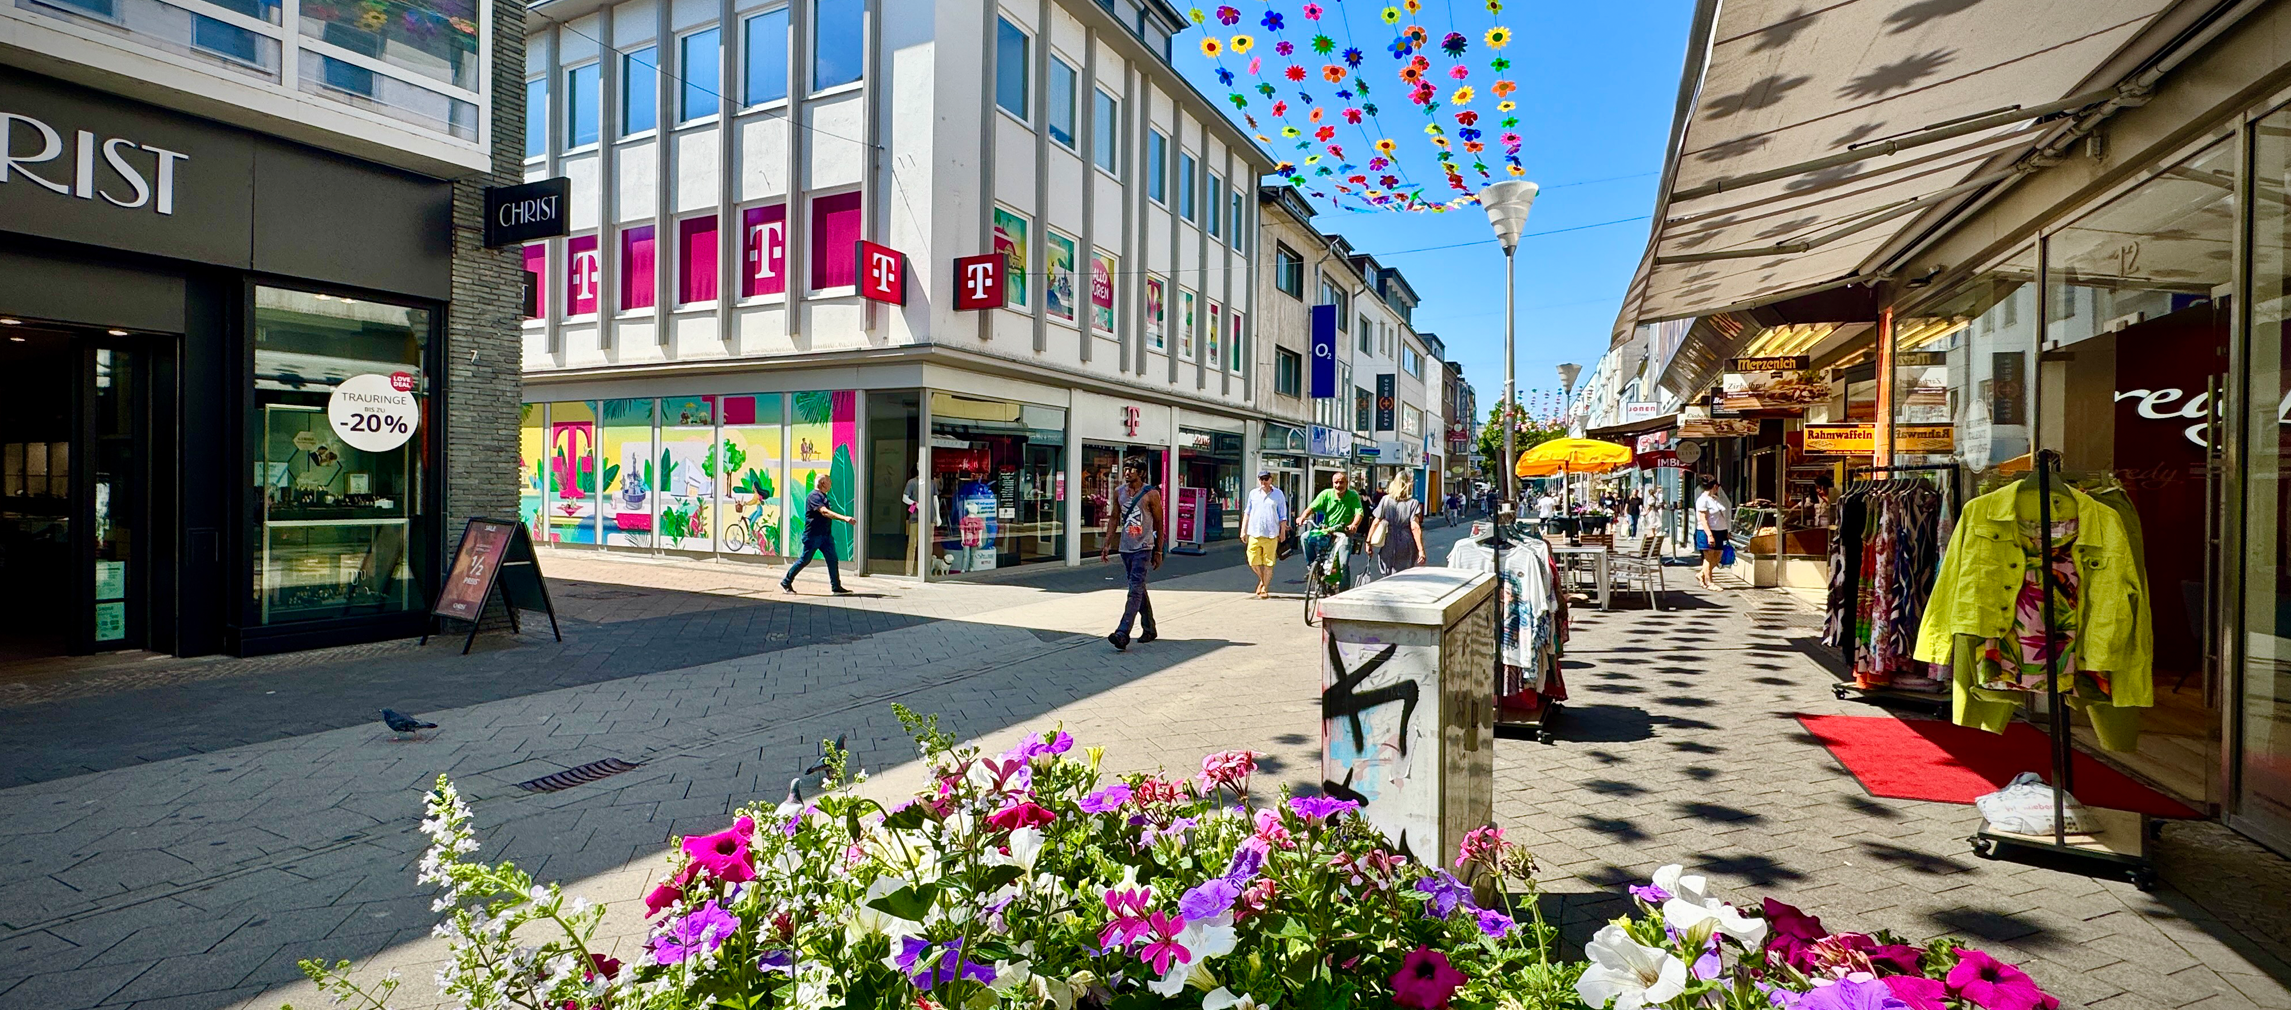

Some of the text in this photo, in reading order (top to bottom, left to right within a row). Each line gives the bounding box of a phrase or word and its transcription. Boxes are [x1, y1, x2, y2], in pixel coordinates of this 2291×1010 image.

[499, 195, 559, 228] CHRIST
[750, 222, 782, 279] T
[872, 252, 895, 293] T
[1093, 268, 1108, 284] ALLO
[967, 262, 994, 300] T
[470, 349, 480, 364] 7
[1315, 343, 1332, 360] O2
[1737, 358, 1796, 371] Merzenich
[393, 375, 411, 383] LOVE
[393, 381, 411, 389] DEAL
[342, 392, 407, 405] TRAURINGE
[340, 413, 408, 434] -20%
[1124, 405, 1140, 437] T
[1807, 429, 1873, 440] Rahmwaffeln
[552, 421, 592, 498] T
[1657, 458, 1693, 467] IMBI
